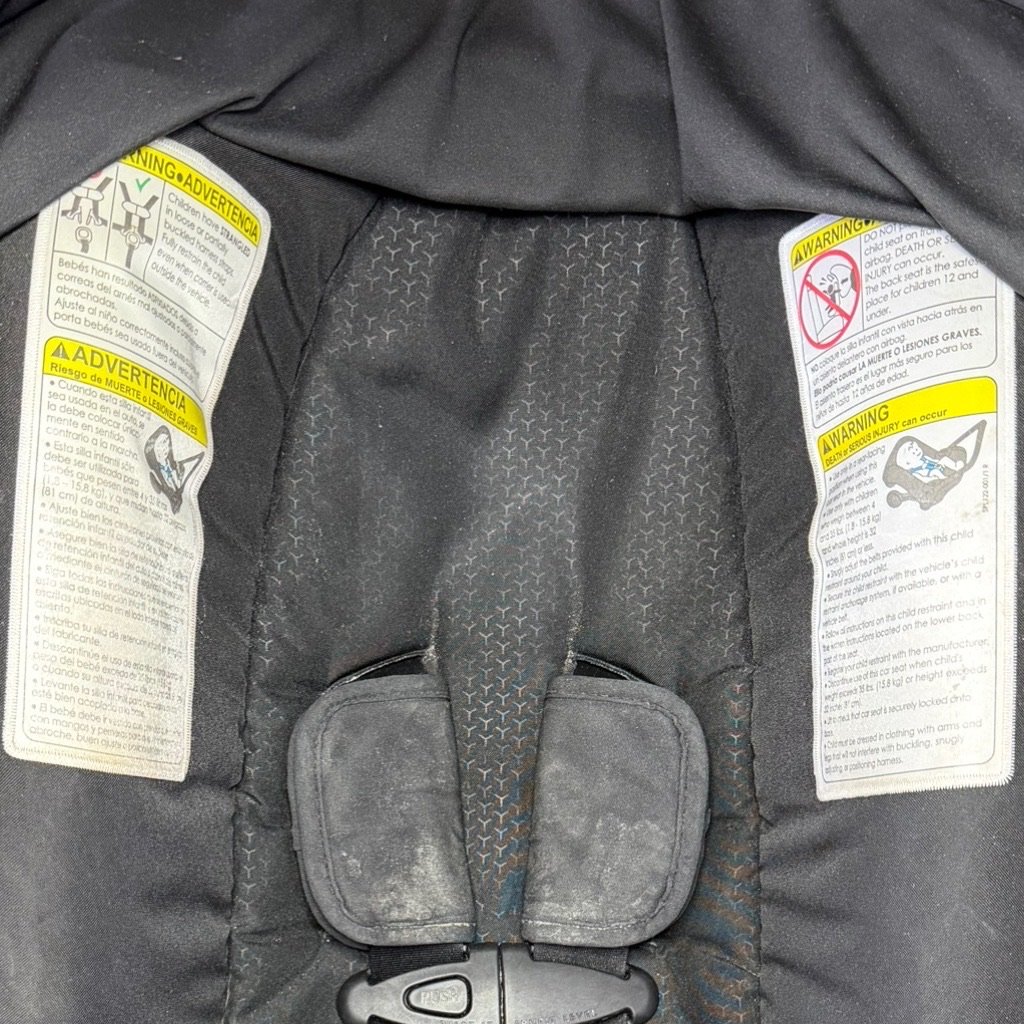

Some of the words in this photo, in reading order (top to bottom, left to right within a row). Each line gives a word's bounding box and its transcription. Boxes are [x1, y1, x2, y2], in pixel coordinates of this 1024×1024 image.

[168, 192, 200, 219] Children
[183, 173, 258, 244] ADVERTENCIA
[162, 232, 178, 252] Fully
[164, 219, 196, 246] buckled
[803, 218, 863, 260] WARNING
[864, 232, 877, 244] DO
[864, 242, 884, 257] child
[885, 236, 906, 250] seat
[906, 232, 918, 242] on
[864, 252, 892, 270] airbag.
[895, 240, 924, 258] DEATH
[926, 237, 942, 248] OR
[157, 248, 175, 266] even
[864, 264, 892, 282] INJURY
[894, 258, 912, 270] can
[913, 252, 945, 264] occur.
[58, 258, 89, 273] Bebés
[91, 265, 110, 280] han
[151, 261, 176, 284] outside
[865, 284, 879, 296] The
[880, 276, 902, 292] back
[903, 268, 924, 282] seat
[934, 260, 950, 273] the
[57, 272, 94, 288] correas
[96, 282, 112, 294] del
[865, 294, 888, 310] place
[890, 287, 902, 300] for
[903, 276, 941, 296] children
[943, 272, 955, 283] 12
[956, 270, 979, 282] and
[56, 285, 117, 310] abrochadas.
[54, 297, 85, 312] Ajuste
[88, 305, 97, 315] al
[99, 309, 118, 324] niño
[865, 305, 892, 322] under.
[916, 308, 942, 326] hacia
[944, 304, 968, 318] atrás
[970, 304, 983, 312] en
[53, 312, 82, 326] porta
[84, 317, 114, 336] bebés
[868, 349, 892, 368] MUERTE
[902, 334, 940, 354] LESIONES
[940, 327, 983, 342] GRAVES.
[905, 350, 934, 367] seguro
[935, 344, 959, 357] para
[960, 341, 974, 351] los
[58, 380, 97, 398] Cuando
[72, 346, 187, 414] ADVERTENCIA
[48, 391, 66, 400] sea
[68, 395, 98, 410] usada
[50, 362, 88, 380] Riesgo
[90, 374, 102, 385] de
[104, 377, 142, 400] MUERTE
[148, 397, 177, 422] LESIONES
[176, 416, 198, 436] GRAVES
[48, 401, 56, 410] la
[59, 404, 86, 418] debe
[88, 411, 121, 429] colocar
[46, 414, 79, 428] mente
[81, 422, 93, 432] en
[95, 426, 125, 443] sentido
[46, 427, 89, 443] contrario
[829, 404, 890, 450] WARNING
[54, 440, 74, 454] Esta
[825, 452, 844, 468] DEATH
[848, 433, 872, 452] SERIOUS
[872, 420, 900, 442] INJURY
[901, 416, 918, 428] can
[919, 409, 948, 422] occur
[44, 451, 70, 464] debe
[50, 502, 78, 517] Ajuste
[882, 541, 912, 559] provided
[914, 536, 932, 548] with
[933, 534, 948, 544] this
[950, 528, 974, 542] child
[918, 558, 959, 575] vehicle's
[960, 555, 985, 568] child
[917, 600, 953, 616] restraint
[930, 612, 956, 625] lower
[42, 664, 80, 679] cuando
[908, 658, 932, 670] when
[42, 678, 80, 693] Levante
[915, 670, 944, 683] height
[918, 696, 948, 708] locked
[420, 988, 459, 1004] PUSH
